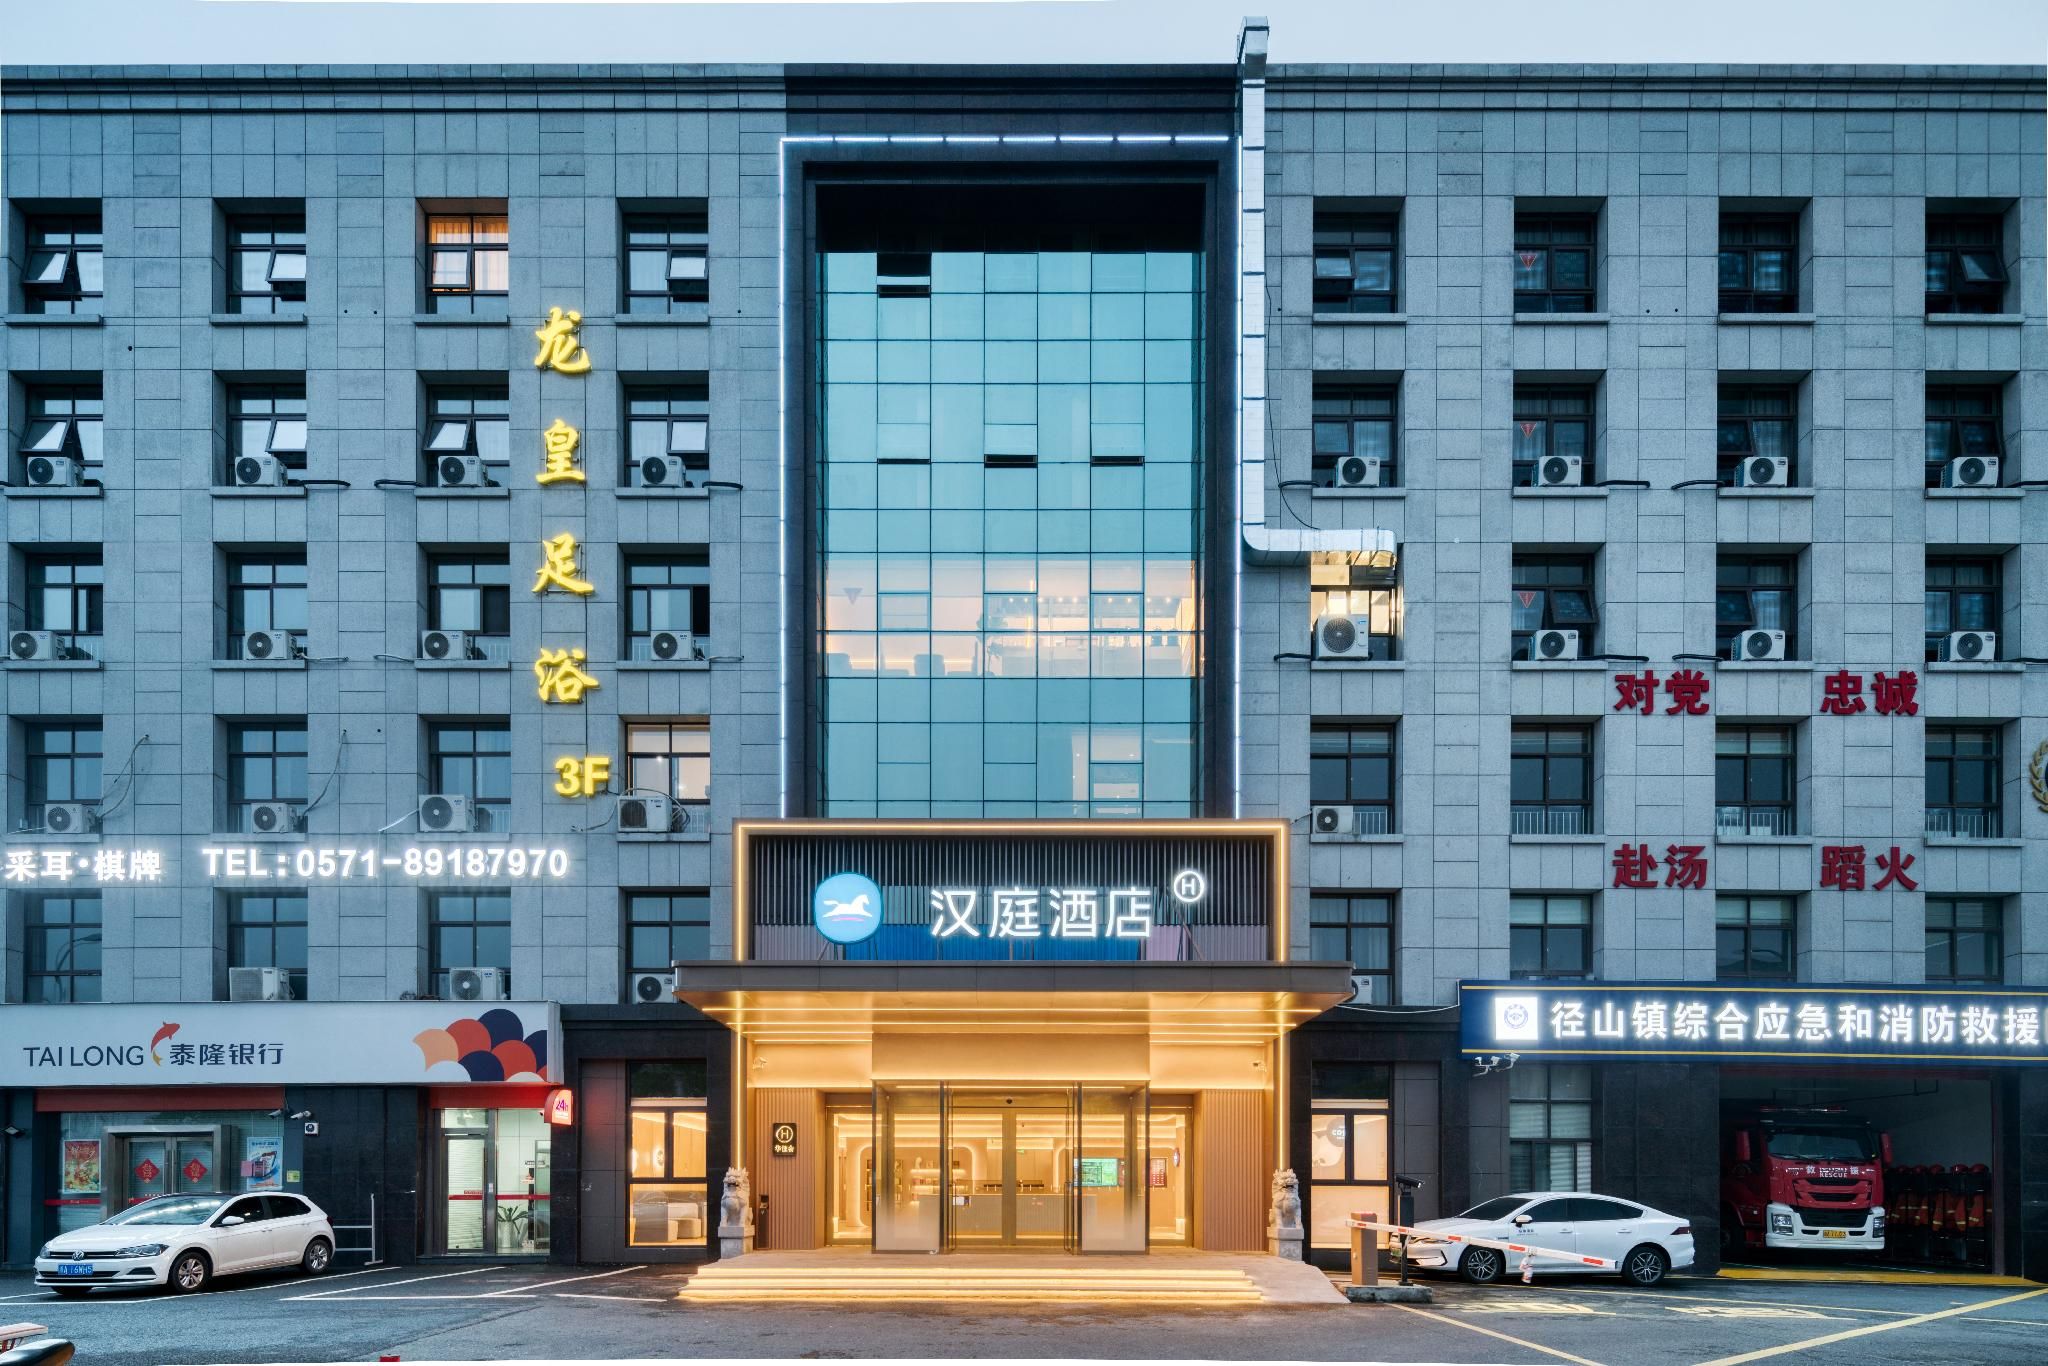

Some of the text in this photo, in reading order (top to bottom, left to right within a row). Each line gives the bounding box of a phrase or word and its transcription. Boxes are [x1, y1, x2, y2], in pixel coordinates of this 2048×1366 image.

[533, 306, 599, 704] 龙皇足浴
[1614, 669, 1919, 716] 对党 忠诚
[554, 754, 612, 797] 3F
[5, 849, 162, 882] 采耳·棋牌
[1613, 844, 1918, 891] 赴汤 蹈火
[930, 885, 1154, 938] 汉庭酒店
[1551, 1000, 2048, 1046] 径山镇综合应急和消防救援
[168, 1042, 284, 1066] 泰隆银行
[555, 1099, 569, 1112] 24h
